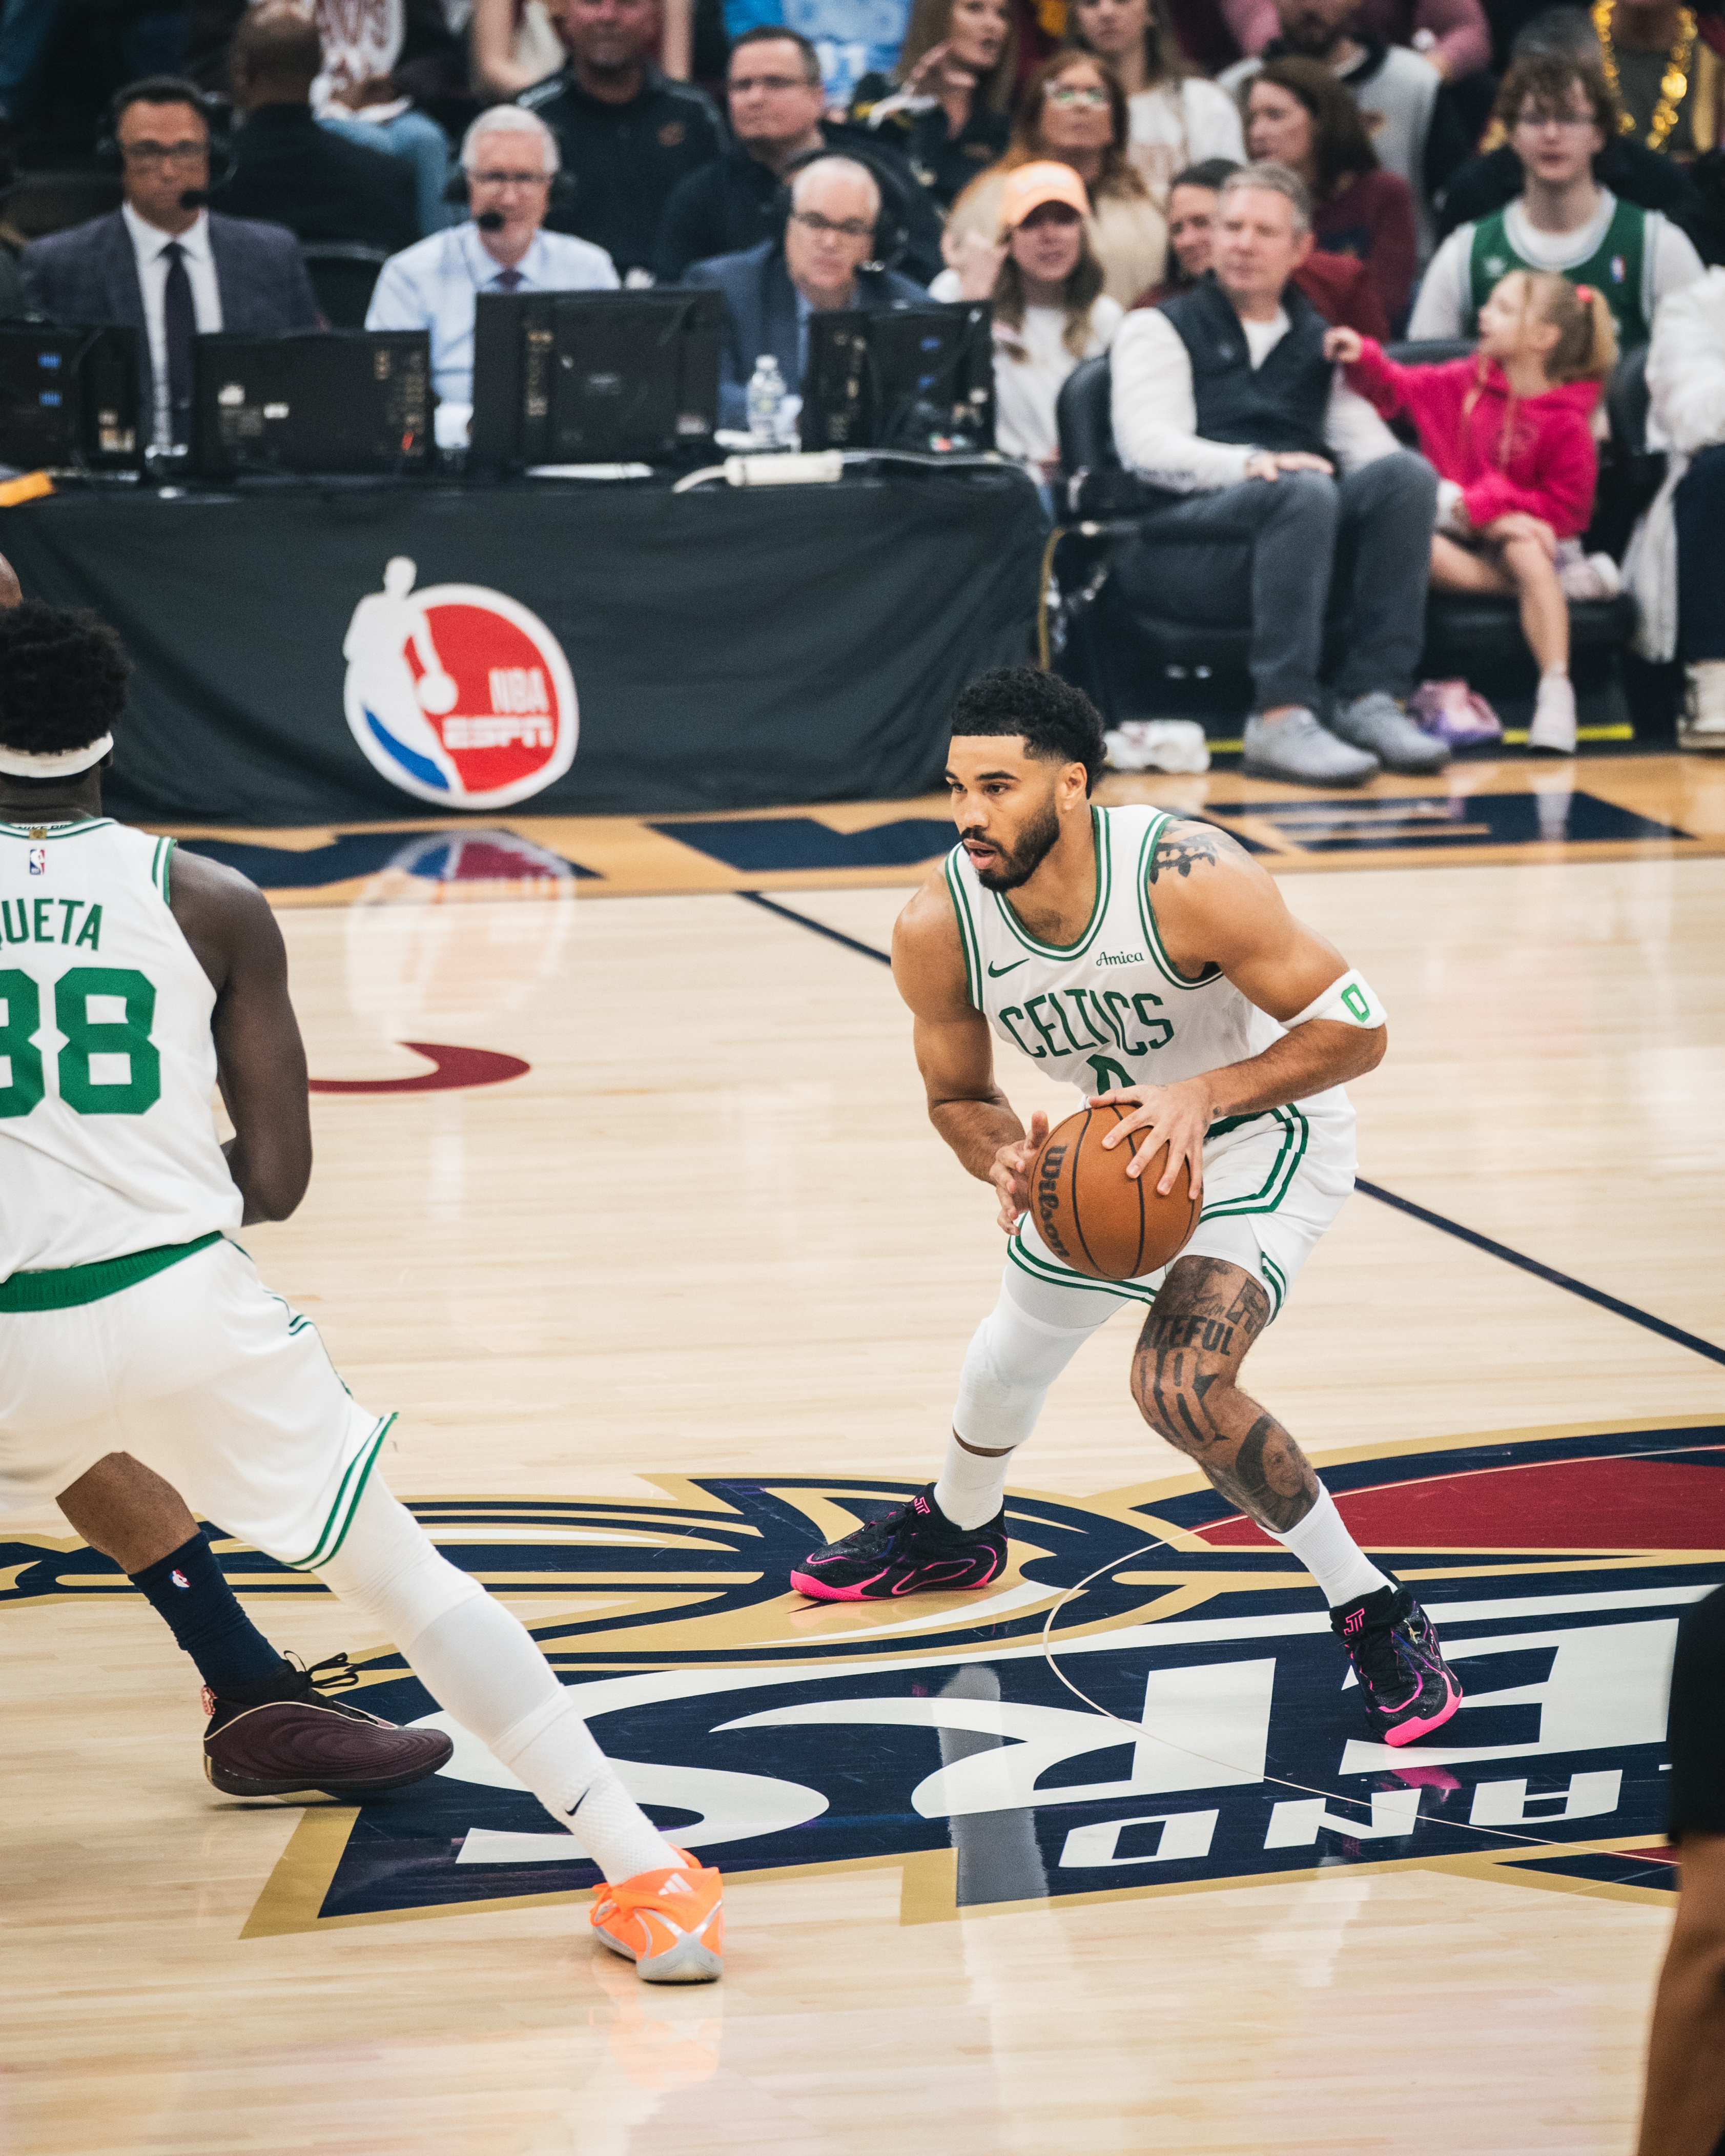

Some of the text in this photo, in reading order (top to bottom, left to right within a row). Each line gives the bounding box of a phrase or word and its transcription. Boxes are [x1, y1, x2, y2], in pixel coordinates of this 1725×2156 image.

[489, 667, 550, 713] NBA
[442, 716, 553, 749] ESPN
[0, 898, 103, 951] UETA
[1096, 951, 1145, 967] Amica
[998, 989, 1175, 1058] CELTICS
[1038, 1143, 1071, 1257] Wilson
[1059, 1764, 1673, 1868] AND
